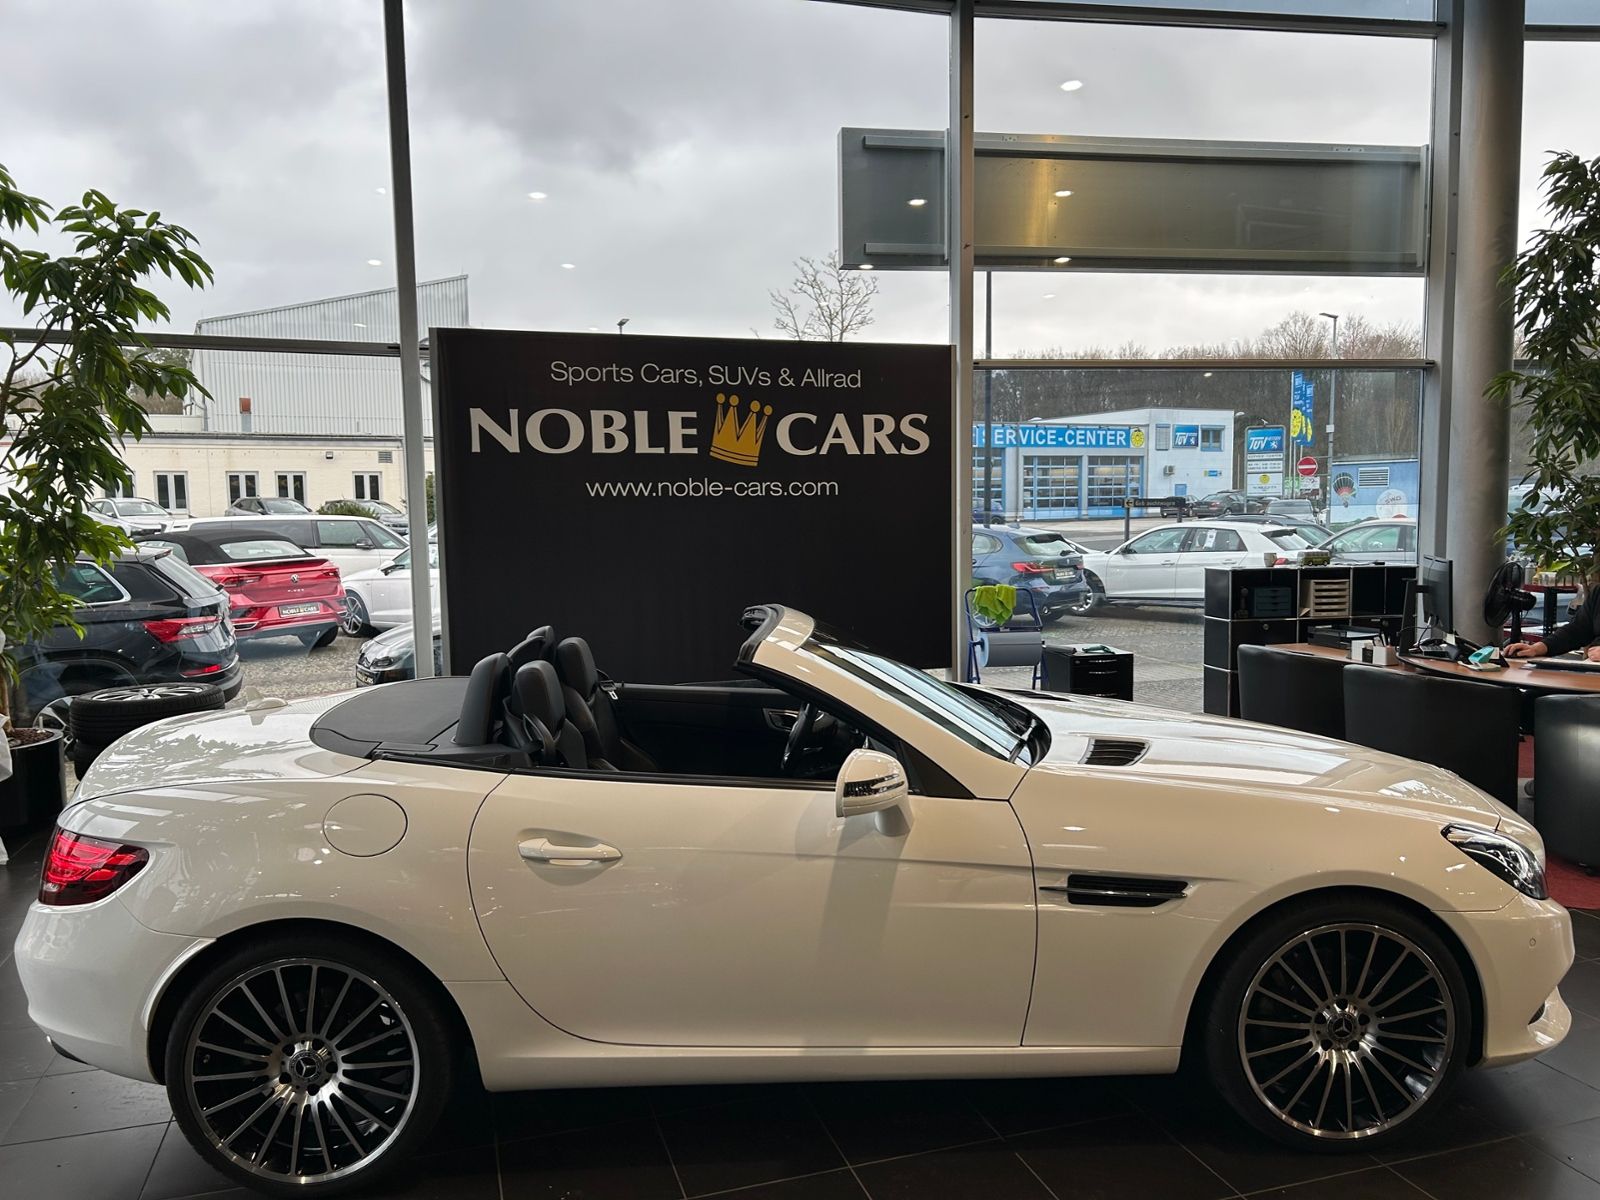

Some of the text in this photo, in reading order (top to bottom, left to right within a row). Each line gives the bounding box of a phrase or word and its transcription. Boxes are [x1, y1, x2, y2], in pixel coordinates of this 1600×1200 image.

[550, 361, 862, 389] Sports Cars, SUVs & Allrad
[469, 407, 931, 456] NOBLE CARS
[586, 477, 840, 499] www.noble-cars.com
